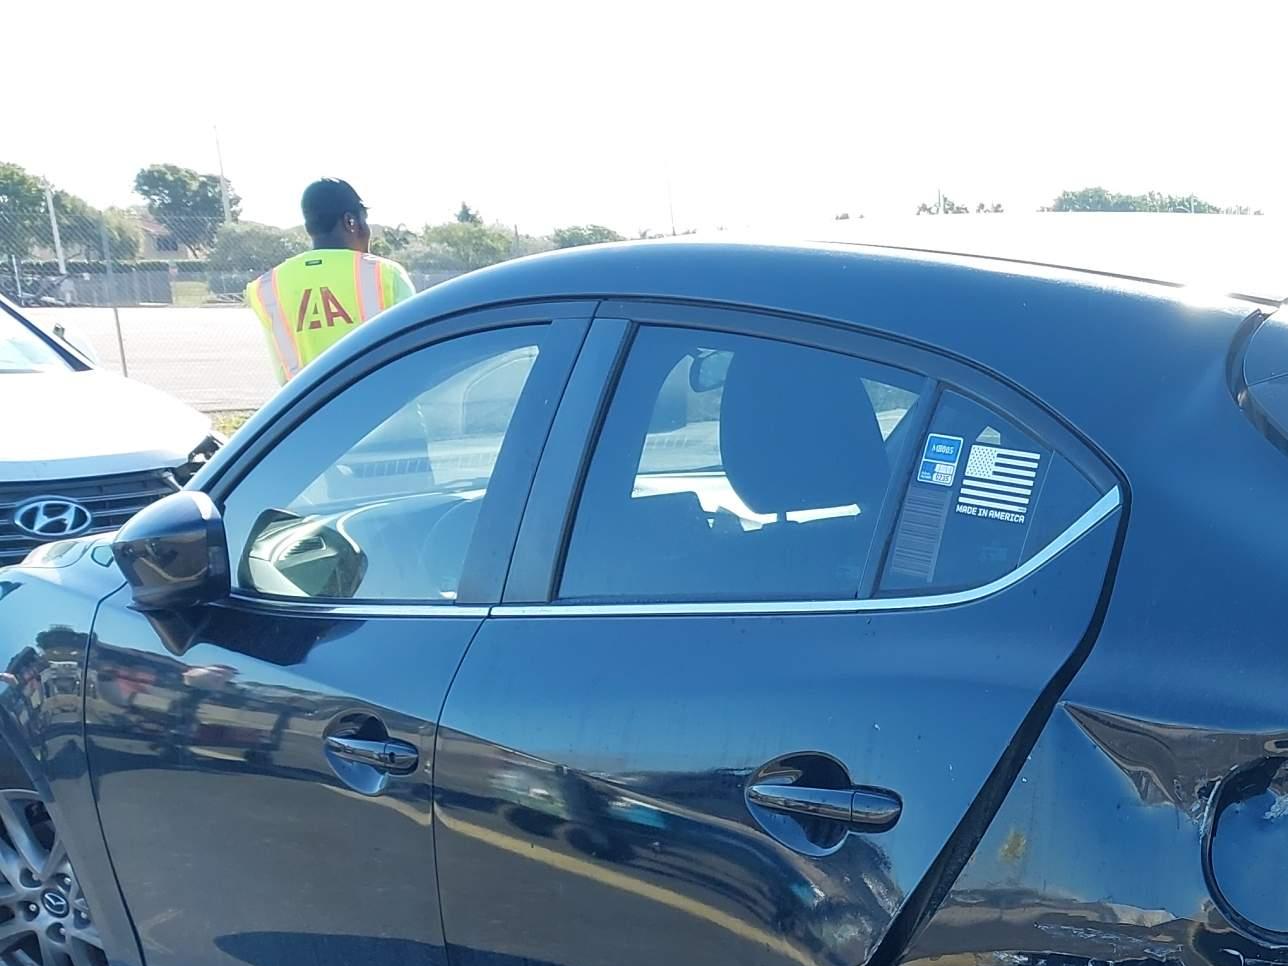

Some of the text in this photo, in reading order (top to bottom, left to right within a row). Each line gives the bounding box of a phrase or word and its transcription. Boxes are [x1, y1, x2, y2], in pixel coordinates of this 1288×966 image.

[955, 503, 1025, 524] MADE IN AMERICA
